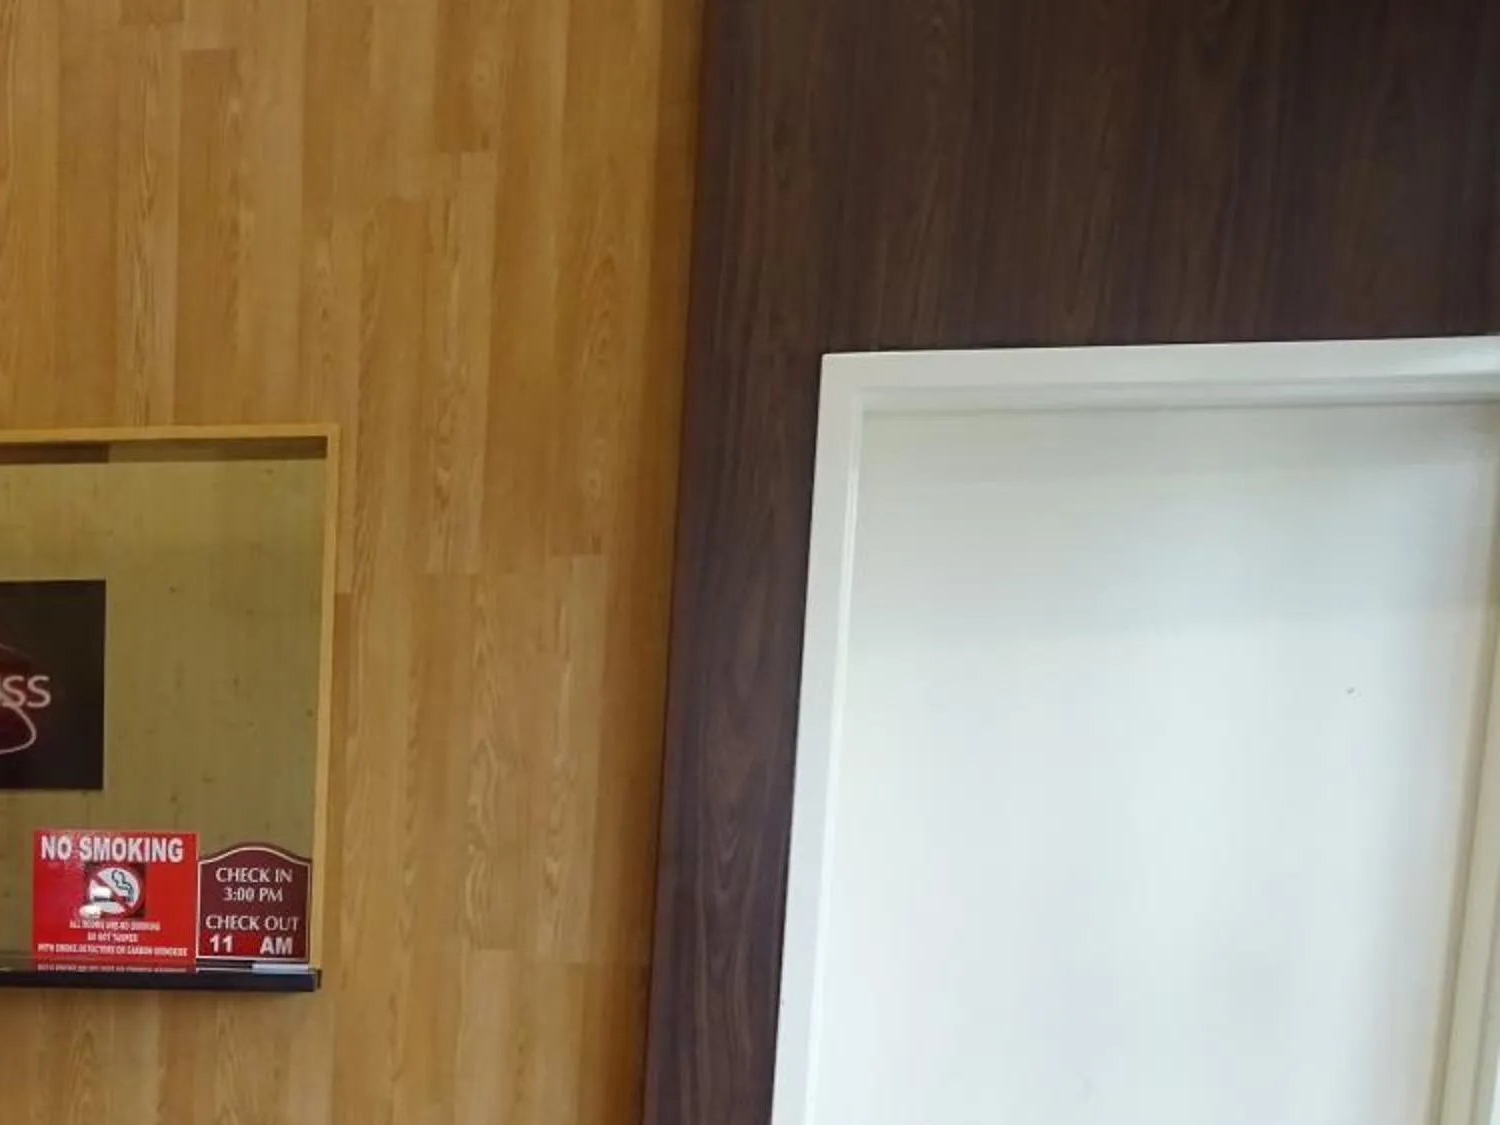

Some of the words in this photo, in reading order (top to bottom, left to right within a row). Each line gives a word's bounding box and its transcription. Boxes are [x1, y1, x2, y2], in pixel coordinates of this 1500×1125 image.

[40, 835, 72, 862] NO
[79, 836, 185, 864] SMOKING
[215, 867, 271, 883] CHECK
[275, 868, 293, 883] IN
[223, 886, 255, 901] 3:00
[259, 887, 284, 902] PM
[205, 914, 260, 931] CHECK
[264, 915, 300, 931] OUT
[209, 934, 234, 953] 11
[260, 936, 293, 955] AM
